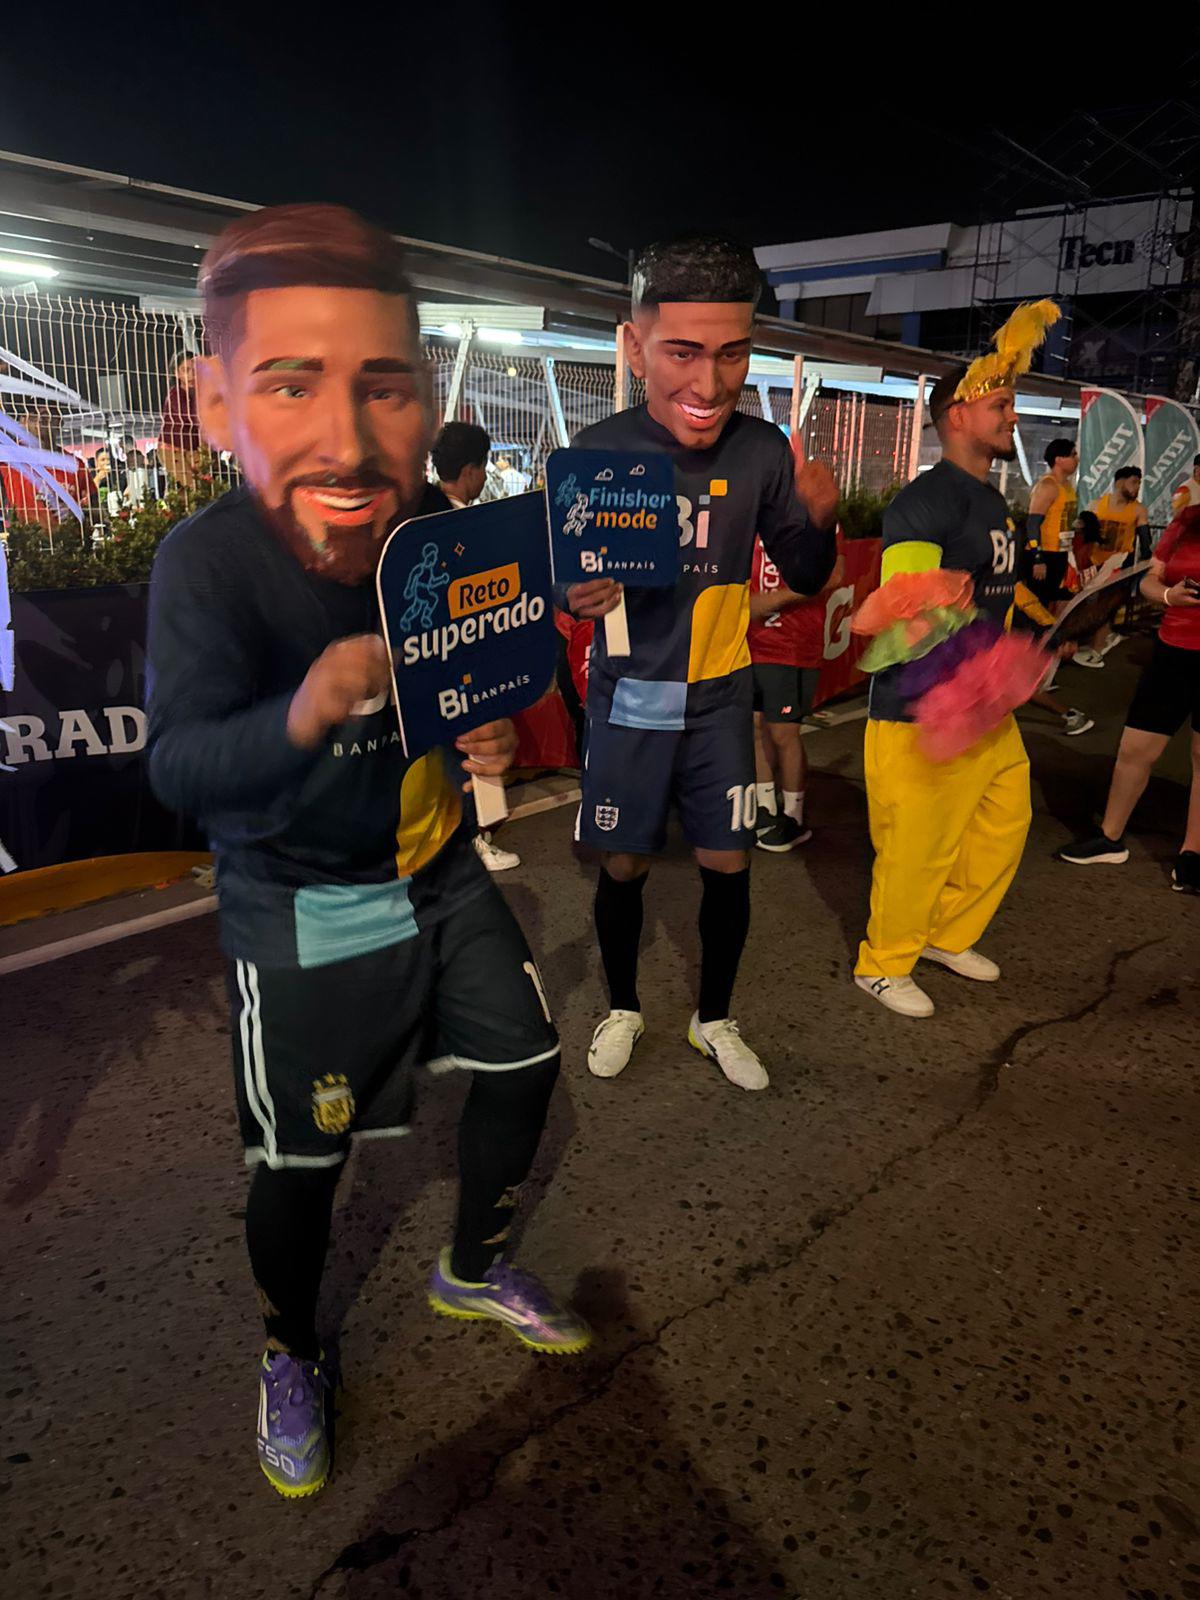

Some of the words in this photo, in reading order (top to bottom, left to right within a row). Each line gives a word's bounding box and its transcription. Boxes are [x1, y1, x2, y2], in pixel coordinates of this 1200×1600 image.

[589, 486, 671, 509] Finisher
[596, 508, 658, 530] mode
[580, 550, 604, 573] Bi
[606, 561, 656, 571] BANPAÍS
[682, 562, 719, 574] PAÍS
[989, 529, 1016, 575] Bi
[459, 578, 510, 609] Reto
[403, 592, 545, 666] superado
[438, 684, 470, 720] Bi
[472, 674, 531, 704] BANPAÍS
[2, 706, 149, 765] RAD
[726, 783, 758, 833] 10
